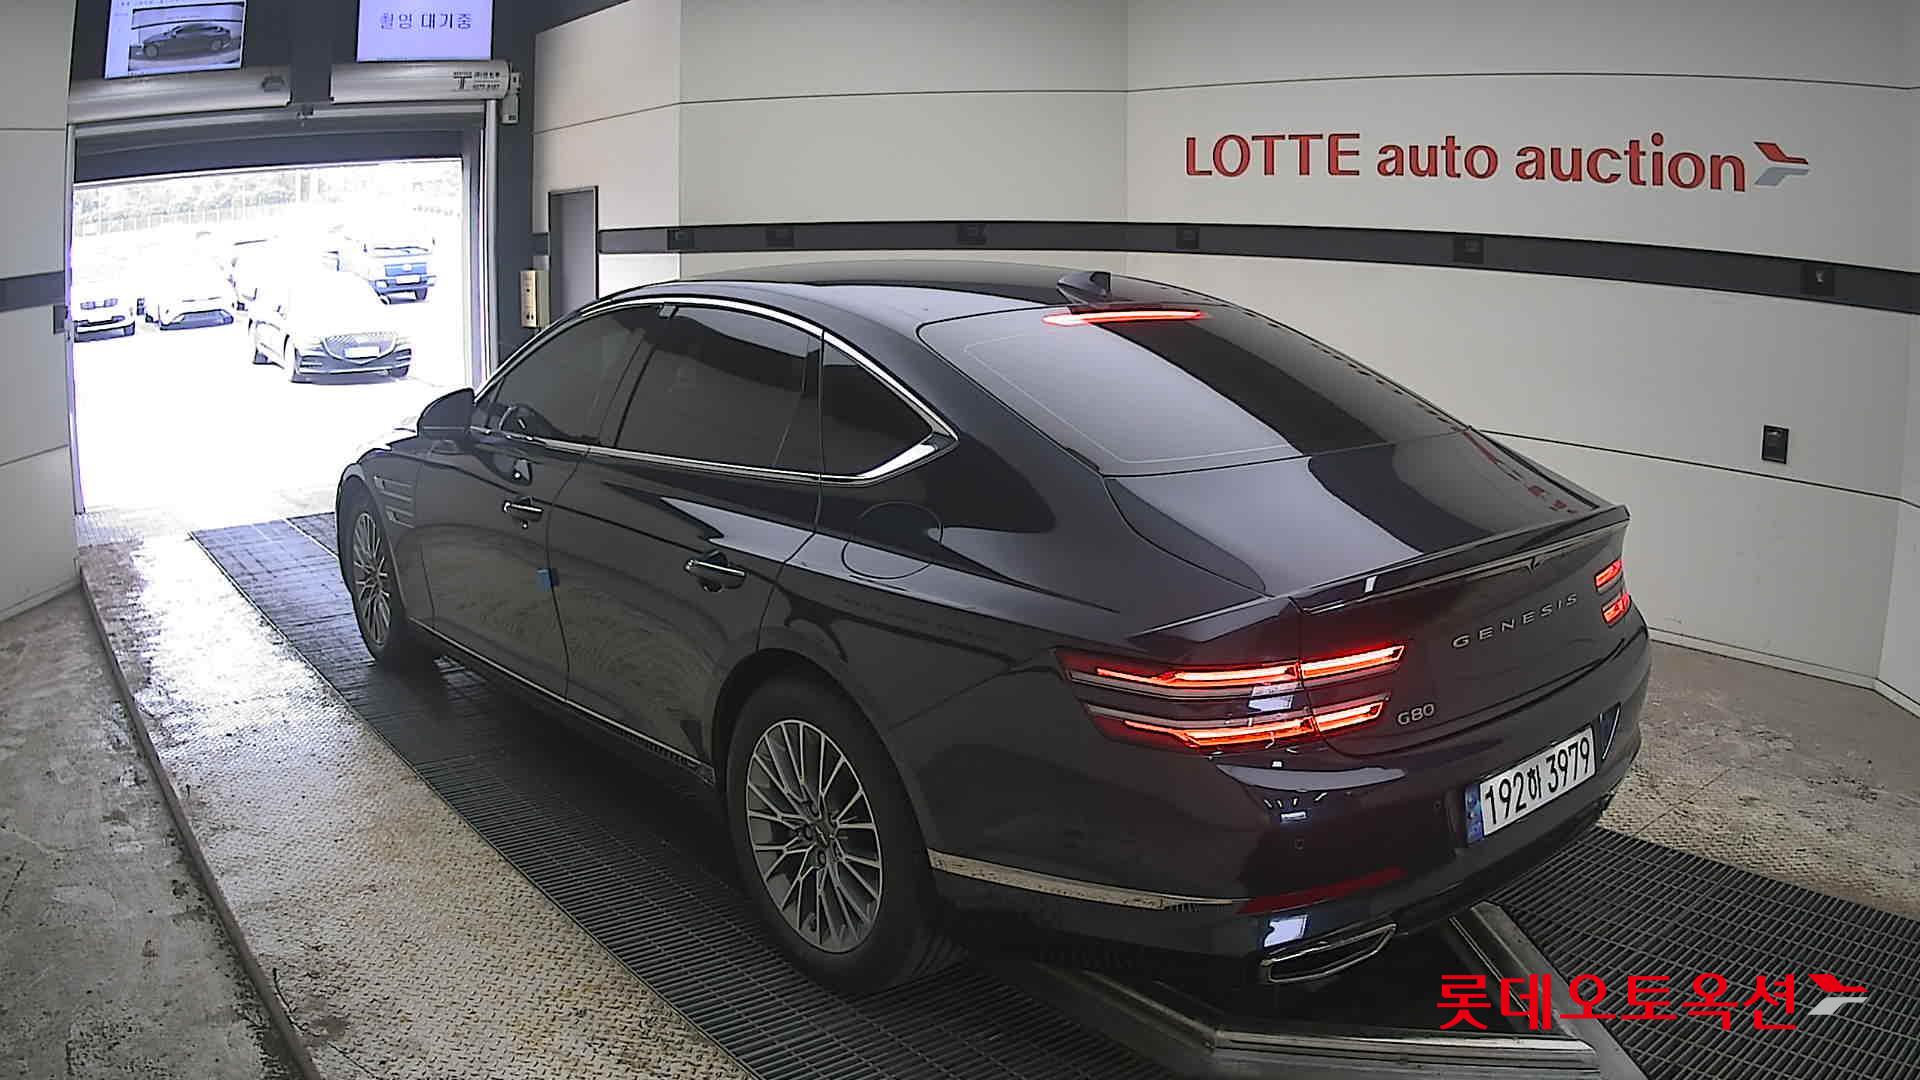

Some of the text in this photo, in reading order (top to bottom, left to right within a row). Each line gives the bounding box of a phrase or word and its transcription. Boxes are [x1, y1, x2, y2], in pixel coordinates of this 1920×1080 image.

[420, 13, 472, 30] 대기중
[1185, 132, 1746, 192] LOTTE auto auction
[1452, 593, 1578, 649] GENESIS
[1397, 703, 1436, 726] G80
[1485, 765, 1542, 825] 192하
[1546, 737, 1590, 793] 3979
